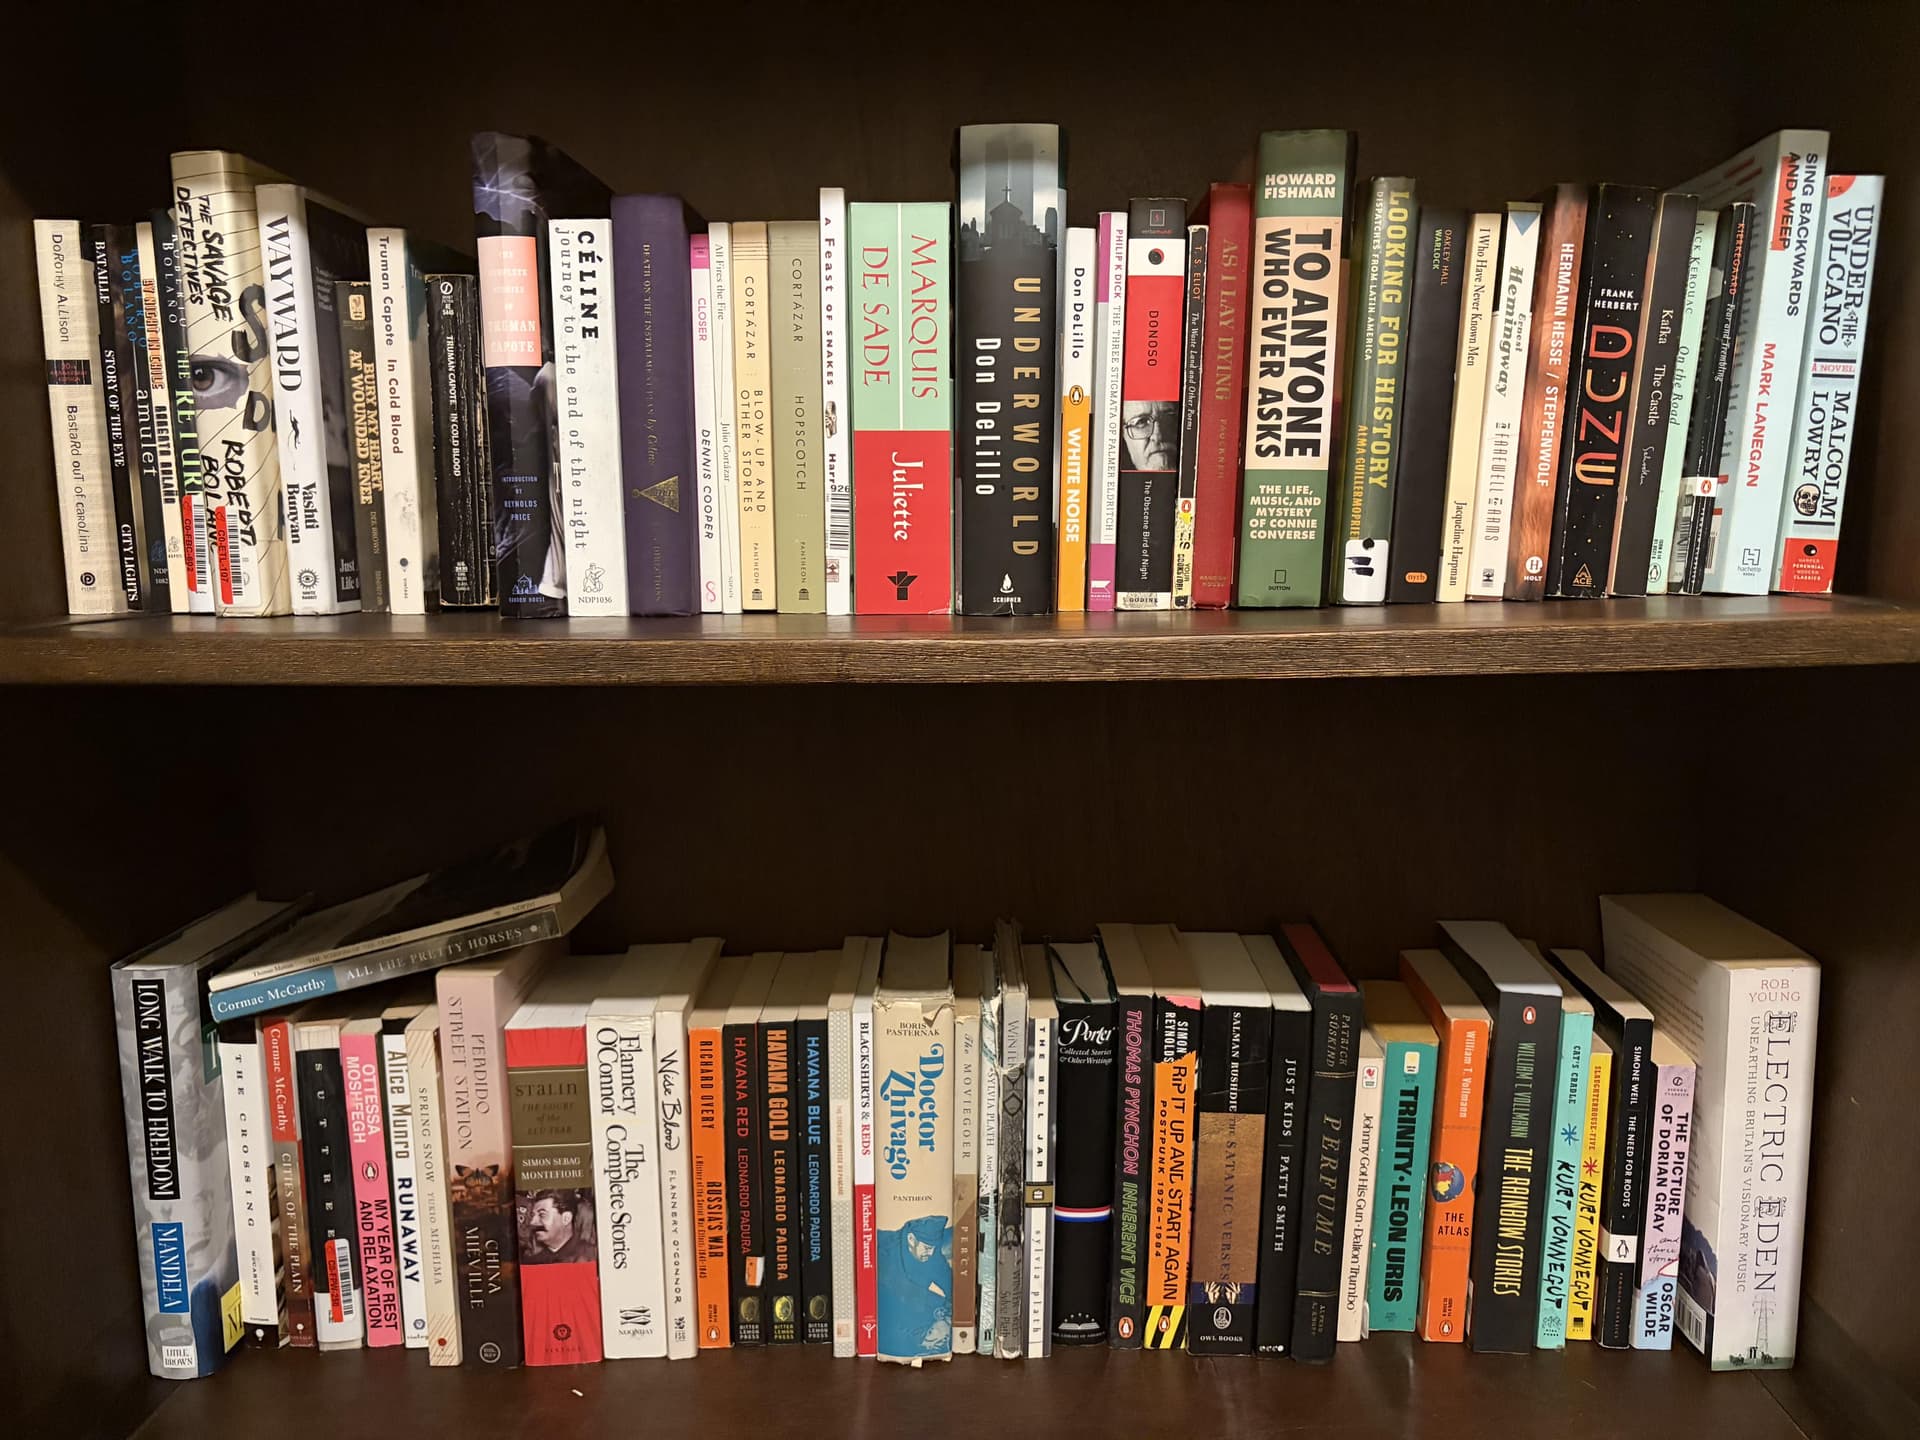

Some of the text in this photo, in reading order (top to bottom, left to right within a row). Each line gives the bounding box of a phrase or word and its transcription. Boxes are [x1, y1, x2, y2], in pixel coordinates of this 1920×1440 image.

[1264, 173, 1336, 186] HOWARD
[1264, 187, 1336, 200] FISHMAN
[177, 186, 203, 305] DETECTIVES
[198, 195, 234, 322] THE SAVAGE
[1432, 228, 1442, 270] WARLOCK
[1440, 229, 1452, 286] OAKLEY HALL
[1786, 153, 1819, 316] SING BACKWARDS
[1818, 209, 1853, 345] VOLCANO
[265, 215, 302, 392] WAYWARD
[379, 236, 395, 346] Truman Capote
[578, 231, 603, 339] CÉLINE
[697, 297, 708, 342] CLOSER
[862, 246, 891, 386] DE SADE
[908, 234, 938, 400] MARQUIS
[1072, 268, 1085, 359] Don DeLillo
[1495, 266, 1525, 398] Hemingway
[446, 335, 458, 404] TRUMAN CAPOTE
[1147, 310, 1159, 367] DONOSO
[1255, 228, 1291, 458] WHO EVER ASKS
[1285, 228, 1332, 457] TO ANYONE
[1369, 190, 1411, 488] LOOKING FOR HISTORY
[1536, 243, 1575, 487] HERMANN HESSE STEPPENWOLF
[388, 359, 404, 454] In Cold Blood
[740, 390, 753, 512] OTHER STORIES
[754, 390, 766, 513] BLOW-UP AND
[794, 395, 806, 490] HOPSCOTCH
[975, 338, 1001, 495] Don DeLillo
[1012, 277, 1041, 556] UNDERWORLD
[1105, 305, 1121, 530] THE THREE STIGMATA OF PALMER ELDRITCH
[1746, 342, 1778, 487] MARK LANEGAN
[1802, 390, 1829, 481] LOWRY
[1820, 389, 1852, 519] MALCOLM
[701, 429, 714, 539] DENNIS COOPER
[892, 451, 924, 541] Juliette
[1066, 428, 1081, 542] WHITE NOISE
[1249, 518, 1318, 529] OF CONNIE
[1256, 507, 1312, 517] MYSTERY
[1250, 529, 1316, 540] CONVERSE
[886, 1028, 940, 1038] PASTERNAK
[1748, 991, 1801, 1003] YOUNG
[1760, 979, 1790, 990] ROB
[596, 1028, 620, 1115] O'Connor
[618, 1034, 643, 1115] Flannery
[699, 1041, 714, 1129] RICHARD OVERY
[734, 1036, 749, 1137] HAVANA RED
[767, 1029, 788, 1141] HAVANA GOLD
[1163, 1012, 1176, 1063] REYNOLDS
[1176, 1021, 1188, 1053] SIMON
[1229, 1012, 1241, 1112] SALMAN RUSHDIE
[1339, 1013, 1351, 1066] PATRICK
[1568, 1045, 1581, 1105] CAT'S CRADLE
[1630, 1045, 1642, 1104] SIMONE WEIL
[137, 983, 174, 1196] LONG WALK TO FREEDOM
[346, 1055, 366, 1142] MOSHFEGH
[362, 1064, 382, 1135] OTTESSA
[418, 1088, 435, 1182] SPRING SNOW
[806, 1036, 820, 1144] HAVANA BLUE
[879, 1068, 916, 1181] Zhivago
[917, 1042, 946, 1153] Doctor
[1122, 1010, 1142, 1175] THOMAS PYNCHON
[1393, 1086, 1419, 1176] TRINITY
[1660, 1104, 1673, 1124] OF
[235, 1055, 256, 1227] THE CROSSING
[521, 1169, 584, 1181] MONTEFIORE
[522, 1157, 581, 1167] SIMON SEBAG
[1313, 1114, 1341, 1256] PERFUME
[1622, 1116, 1637, 1208] THE NEED FOR ROOTS
[1656, 1129, 1671, 1187] DORIAN
[1668, 1112, 1689, 1215] THE PICTURE
[1736, 1016, 1760, 1293] UNEARTHING BRITAIN'S VISIONARY MUSIC
[282, 1153, 302, 1294] CITIES OF THE PLAIN
[397, 1177, 420, 1283] RUNAWAY
[603, 1125, 632, 1269] Complete Stories
[737, 1148, 751, 1254] LEONARDO PADURA
[774, 1149, 788, 1281] LEONARDO PADURA
[808, 1154, 821, 1261] LEONARDO PADURA
[862, 1193, 872, 1269] Michael Parenti
[892, 1194, 933, 1202] PANTHEON
[1275, 1155, 1290, 1252] PATTI SMITH
[1383, 1184, 1411, 1302] LEON URIS
[1438, 1225, 1470, 1237] ATLAS
[1493, 1148, 1533, 1297] THE RAINBOW STORIES
[1652, 1192, 1666, 1233] GRAY
[157, 1226, 183, 1308] MANDELA
[374, 1199, 398, 1330] MY YEAR OF REST
[960, 1226, 969, 1277] PERCY
